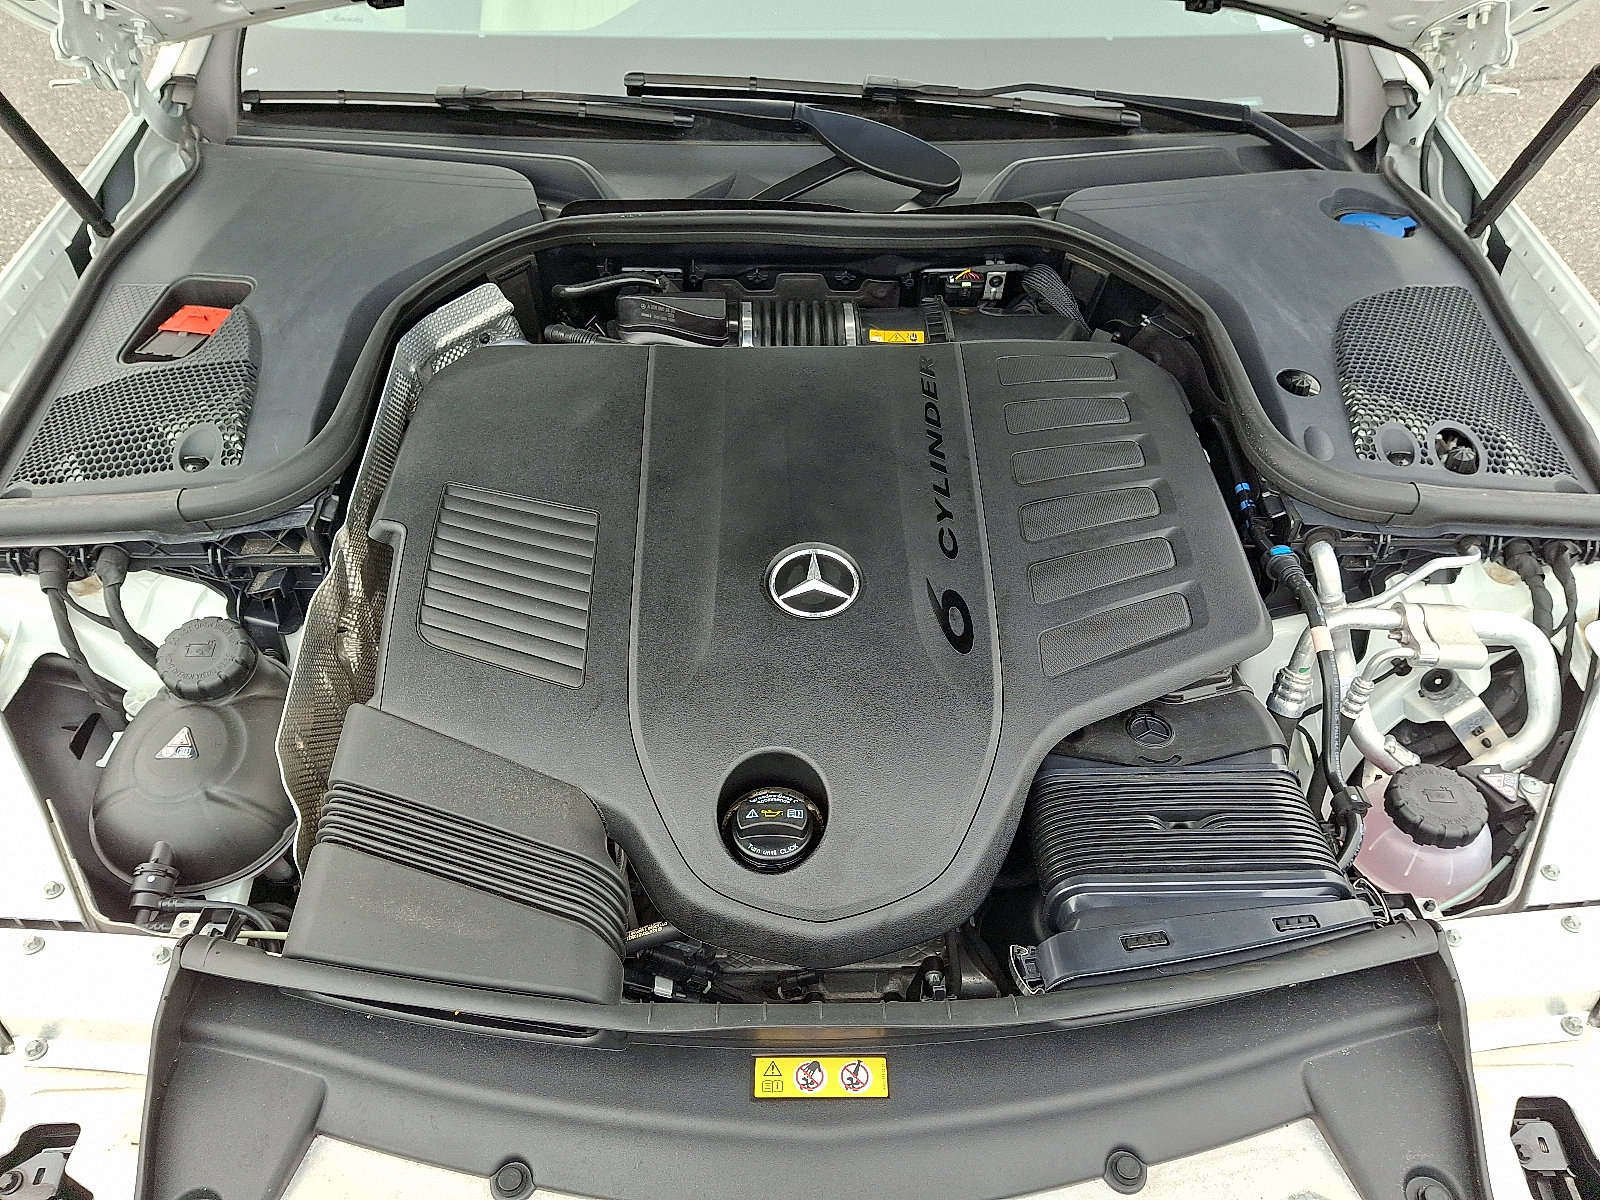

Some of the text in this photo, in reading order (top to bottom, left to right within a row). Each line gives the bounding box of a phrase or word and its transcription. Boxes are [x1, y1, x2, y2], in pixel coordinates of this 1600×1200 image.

[918, 354, 974, 655] 6 CYLINDER
[748, 843, 761, 854] Turn
[779, 842, 799, 855] CLICK
